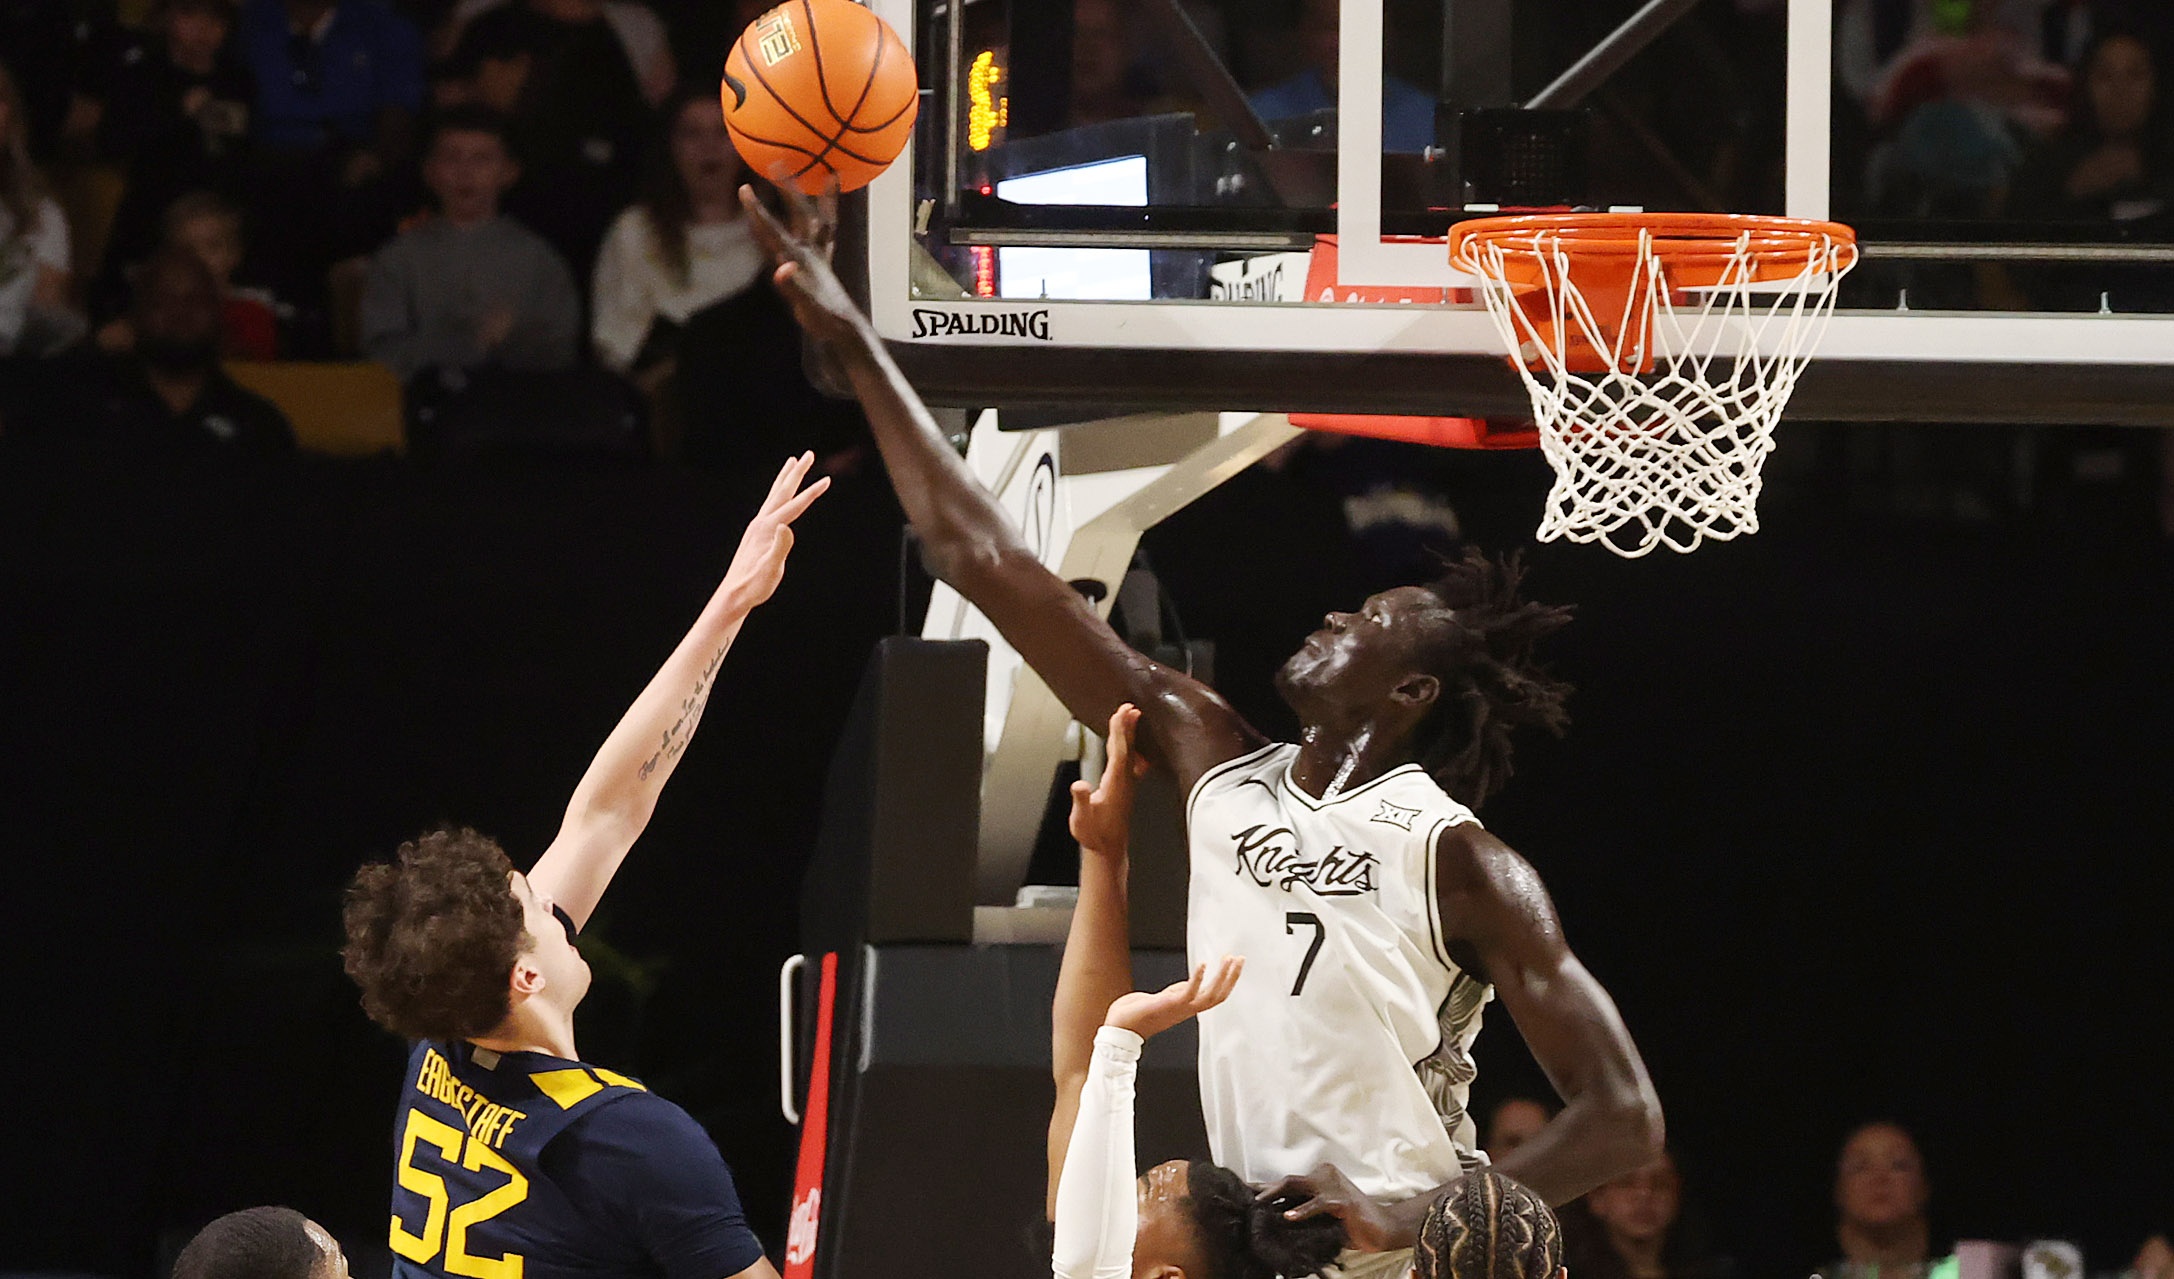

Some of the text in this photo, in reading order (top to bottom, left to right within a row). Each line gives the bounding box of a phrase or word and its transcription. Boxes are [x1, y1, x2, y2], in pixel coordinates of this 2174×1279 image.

[912, 308, 1049, 340] SPALDING
[1231, 824, 1380, 896] Knights
[1286, 912, 1325, 996] 7
[389, 1107, 530, 1279] 52
